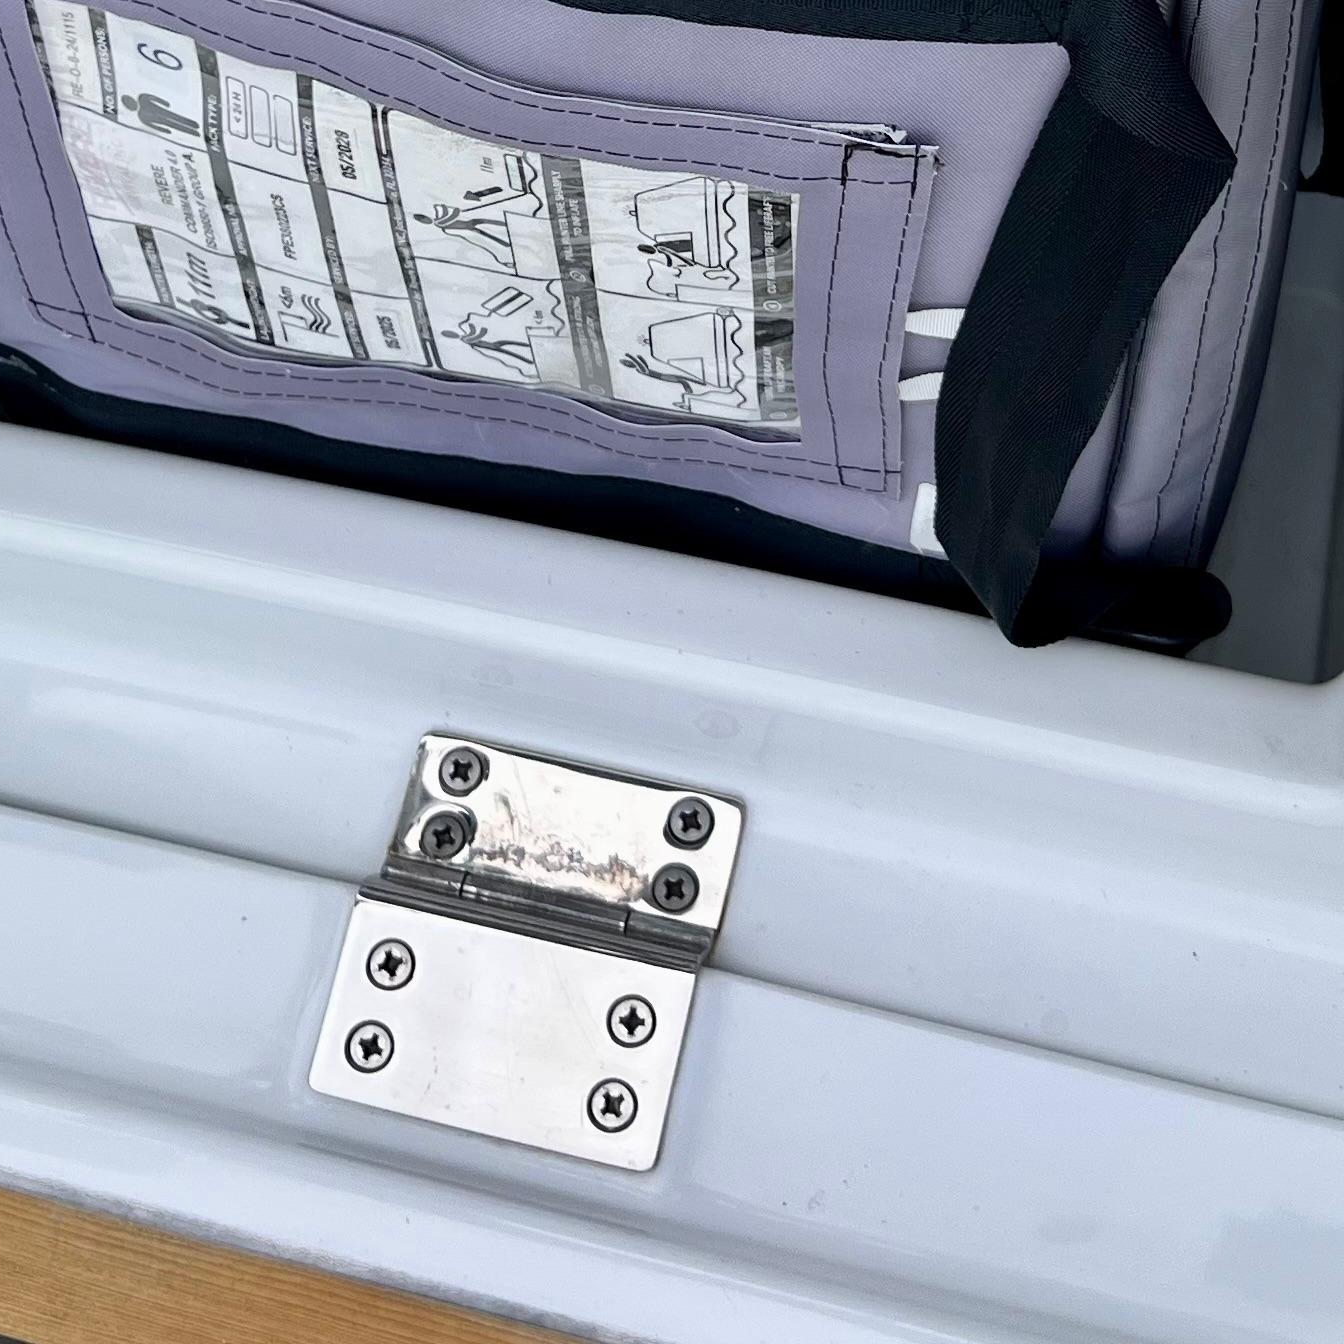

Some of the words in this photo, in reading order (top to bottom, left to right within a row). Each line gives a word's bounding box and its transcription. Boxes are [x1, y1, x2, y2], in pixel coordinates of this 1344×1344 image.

[137, 43, 183, 70] 6
[335, 129, 357, 180] 05/2028
[150, 164, 175, 206] REVERE
[170, 166, 198, 234] COMMANDER
[551, 170, 565, 201] SHARPLY
[762, 197, 774, 231] LIFERAFT
[764, 230, 774, 247] FREE
[184, 252, 216, 299] 11m
